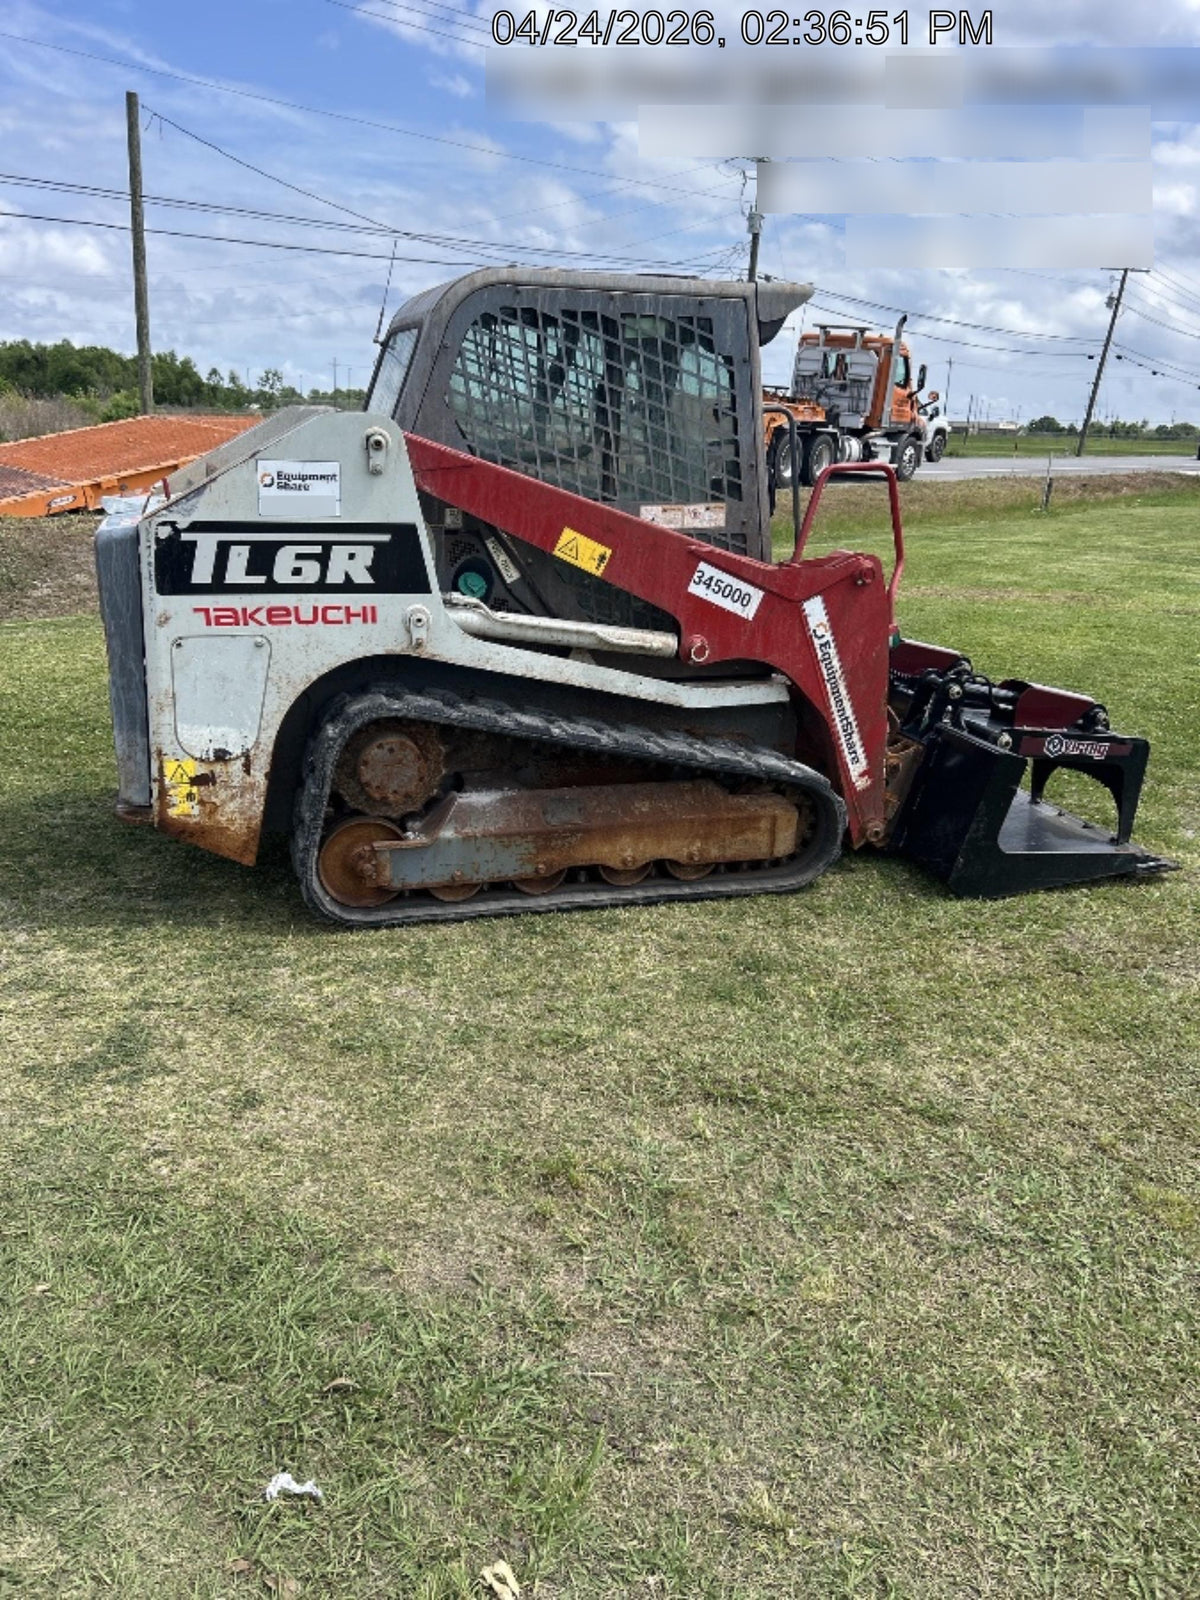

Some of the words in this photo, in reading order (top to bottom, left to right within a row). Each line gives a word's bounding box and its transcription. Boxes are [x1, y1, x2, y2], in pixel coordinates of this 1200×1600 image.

[276, 471, 338, 483] Equipment
[276, 481, 309, 492] Share
[182, 533, 391, 585] TL6R
[692, 568, 752, 608] 345000
[193, 605, 378, 627] TAKEUCHI
[817, 638, 860, 767] EquipmentShare
